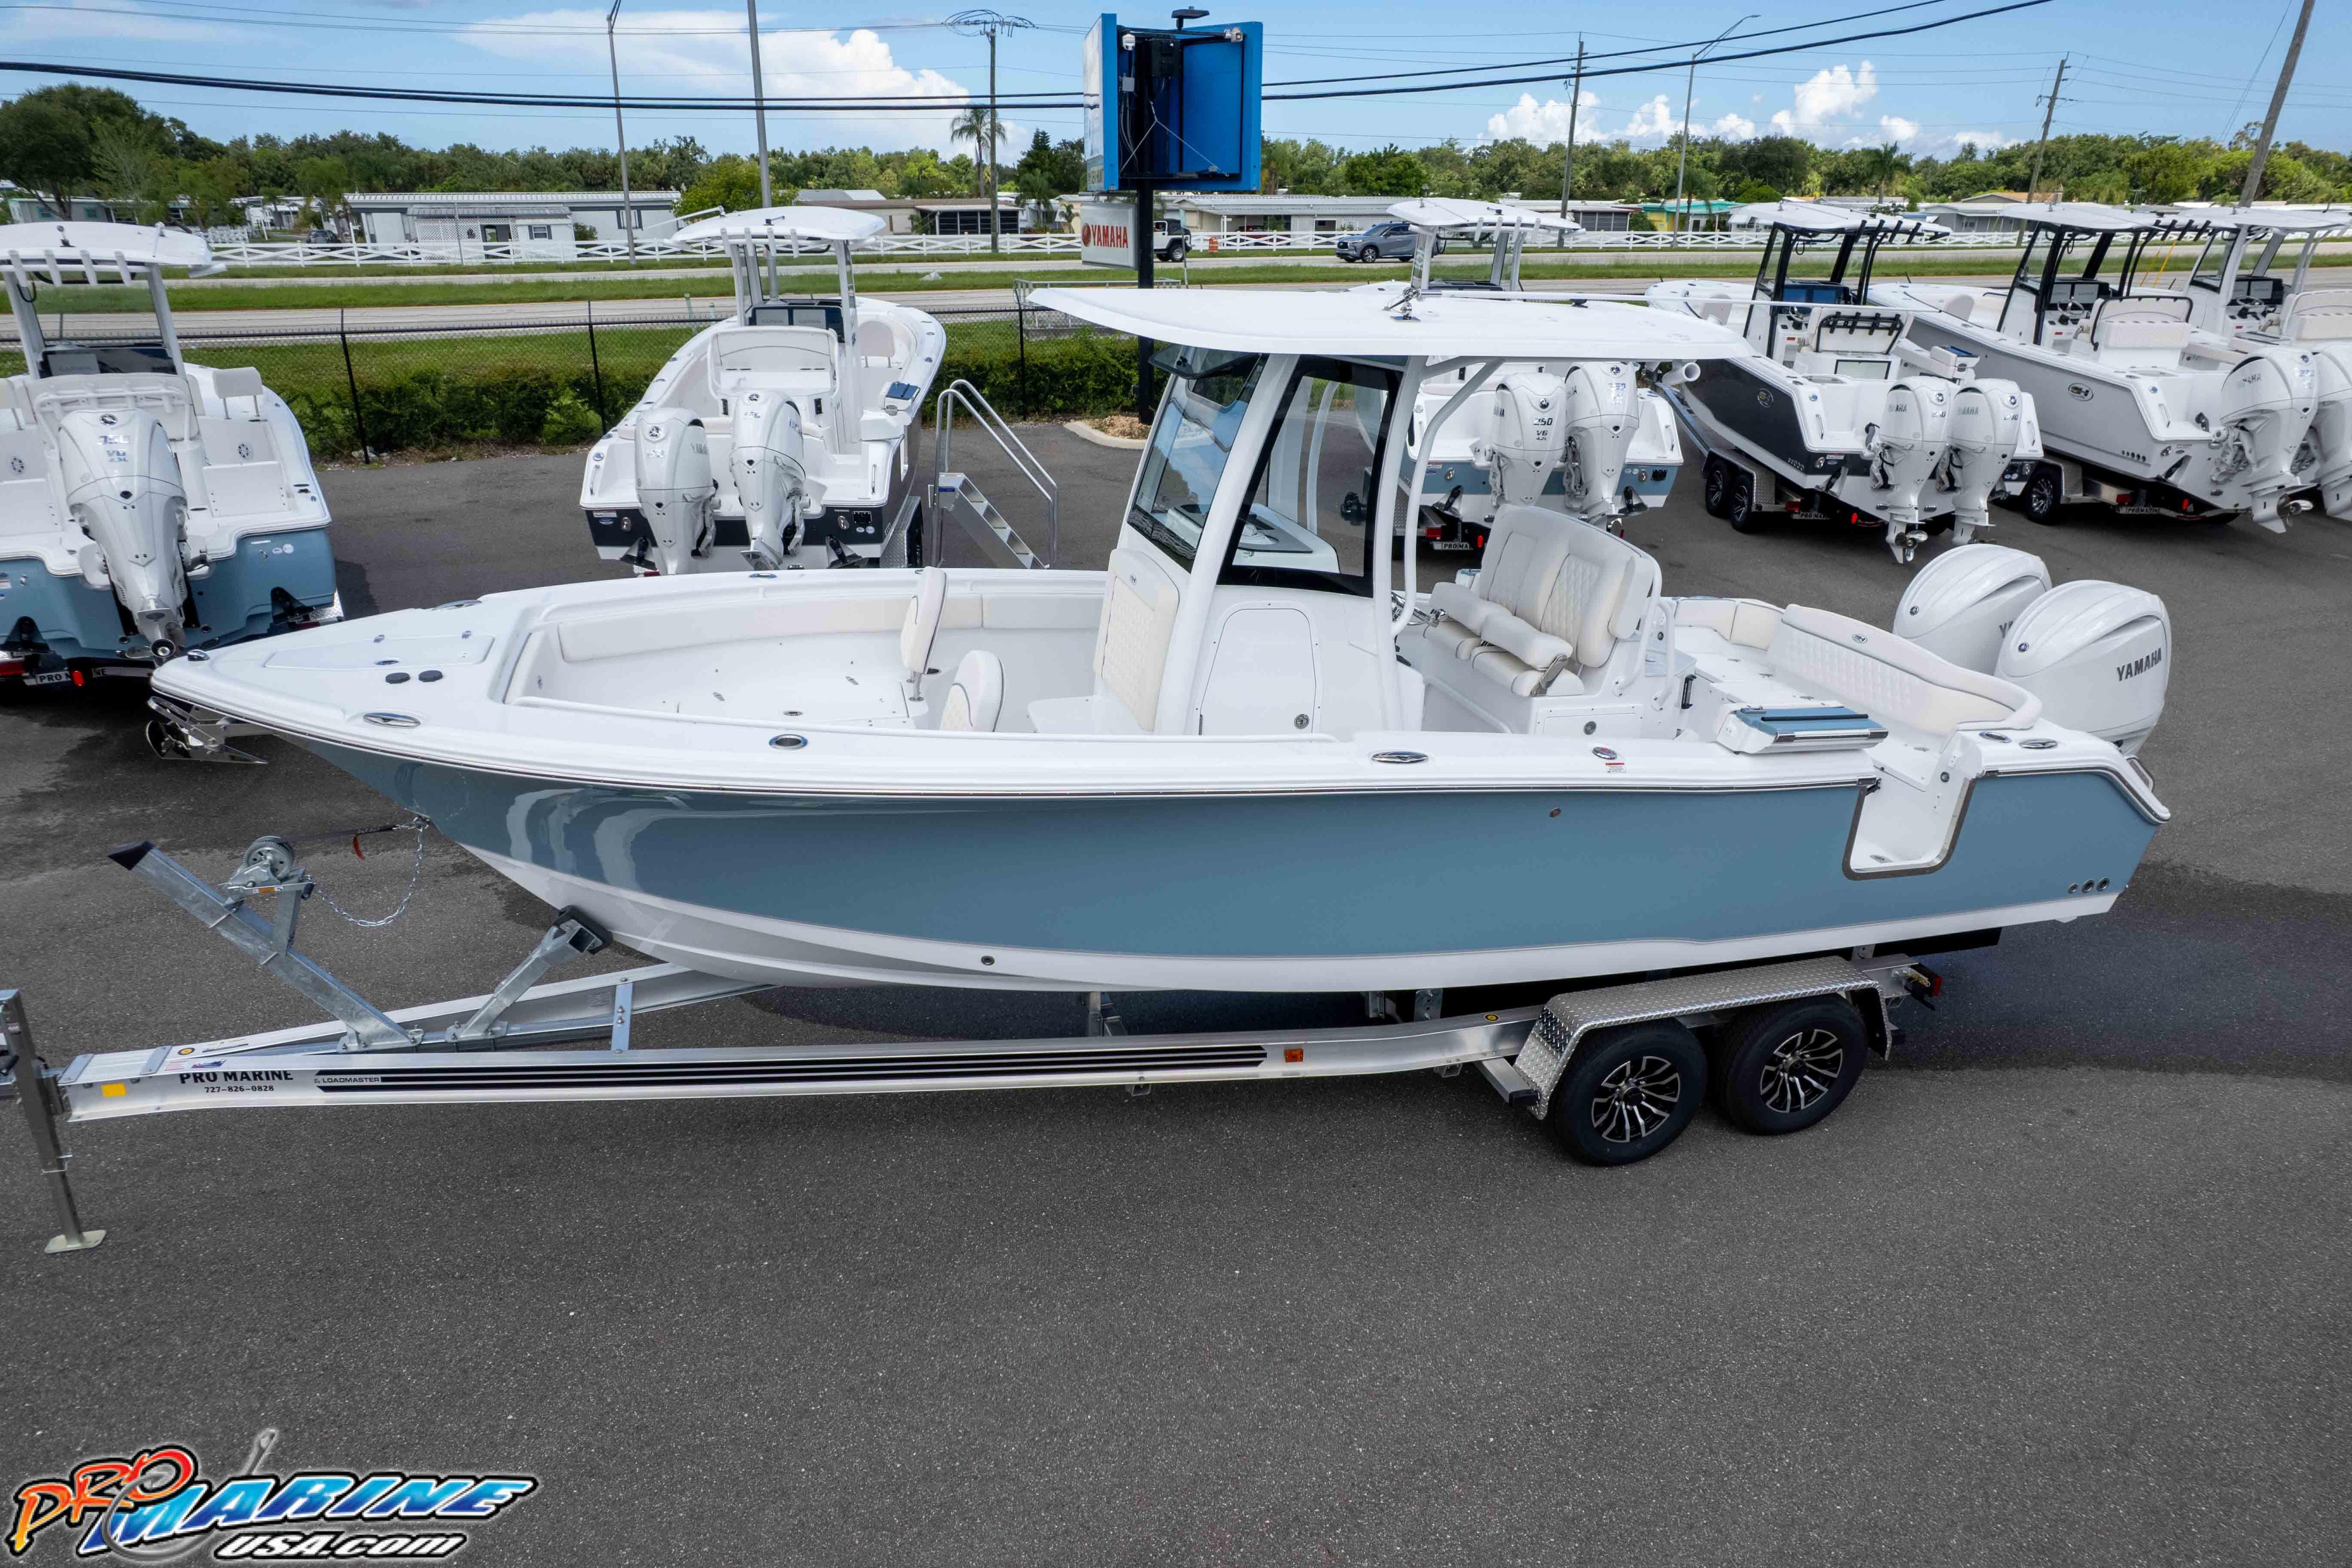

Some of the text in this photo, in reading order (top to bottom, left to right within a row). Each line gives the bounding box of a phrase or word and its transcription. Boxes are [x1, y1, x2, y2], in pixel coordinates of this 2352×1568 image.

[1092, 224, 1128, 249] YAMAHA
[1534, 417, 1553, 426] 250
[2116, 647, 2162, 681] YAMAHA
[39, 674, 62, 683] PRO
[180, 1070, 294, 1084] PRO MARINE
